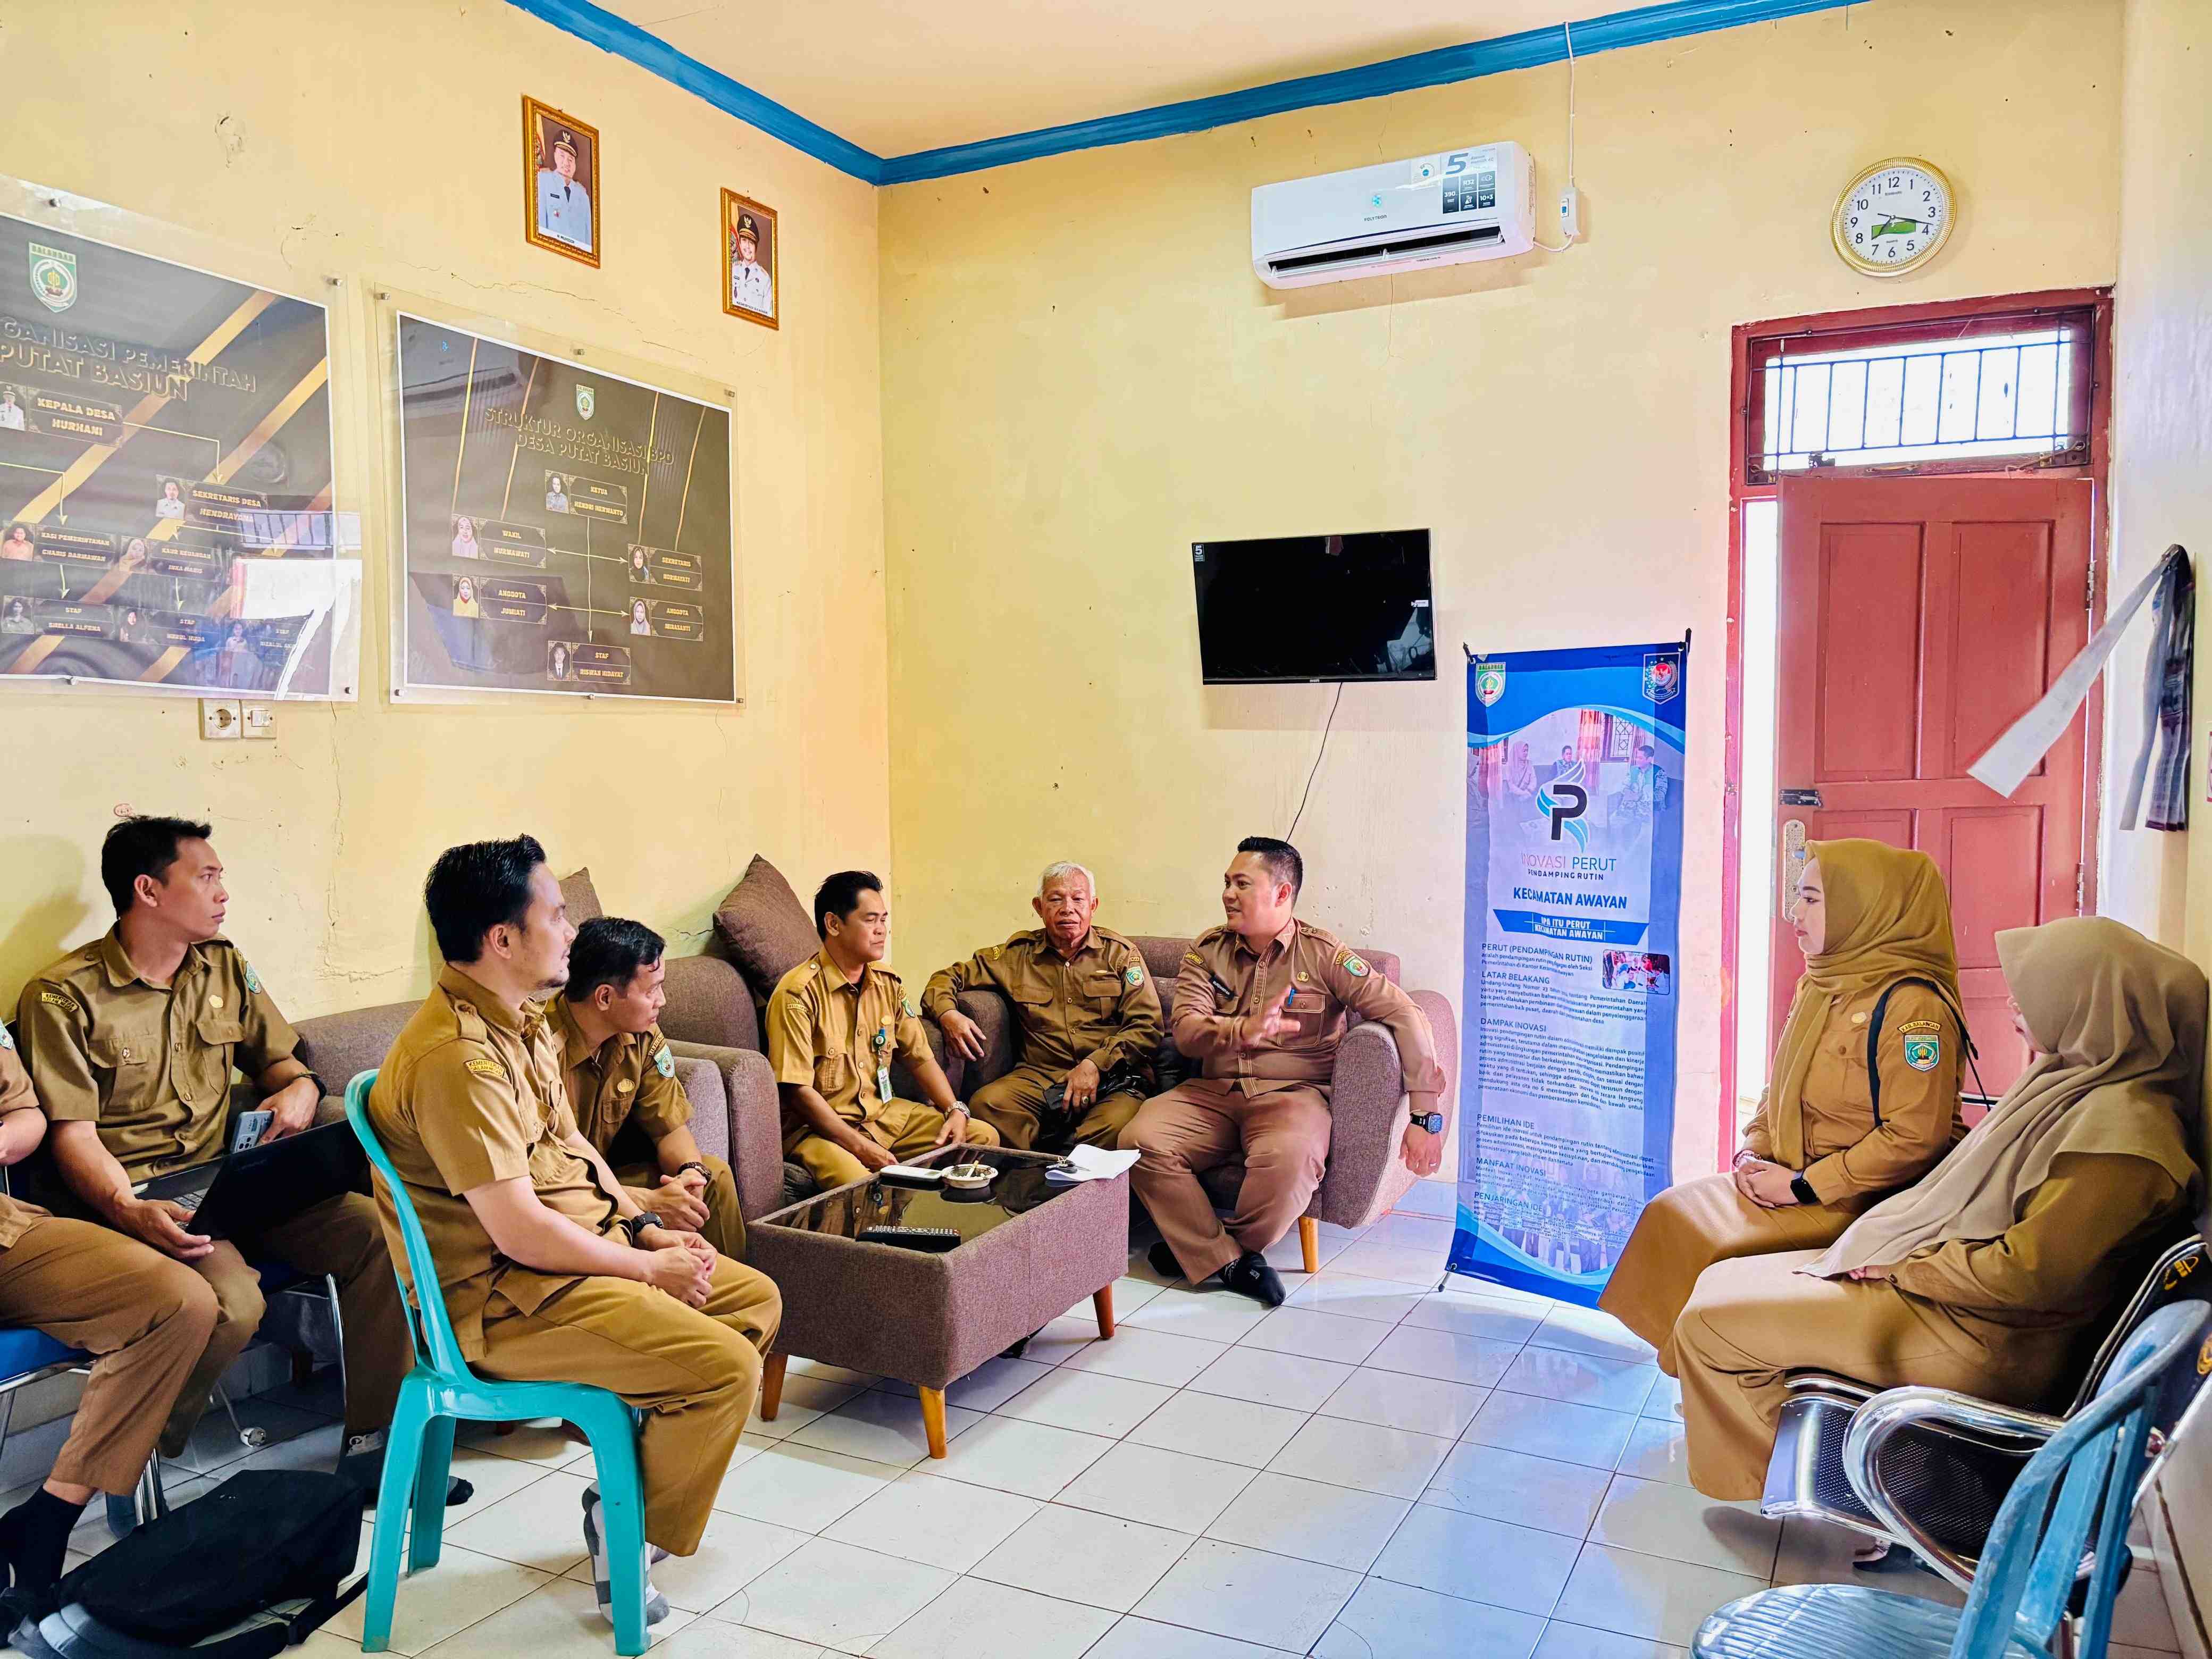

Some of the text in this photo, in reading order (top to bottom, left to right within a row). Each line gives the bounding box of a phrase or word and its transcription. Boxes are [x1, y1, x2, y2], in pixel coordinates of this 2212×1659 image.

[1445, 153, 1468, 174] 5
[1889, 177, 1899, 188] 12
[1910, 179, 1913, 189] 1
[1872, 183, 1881, 195] 11
[1923, 191, 1930, 202] 2
[1857, 199, 1869, 210] 10
[1928, 207, 1936, 217] 3
[1850, 217, 1858, 228] 9
[1922, 224, 1929, 235] 4
[1856, 233, 1863, 244] 8
[1872, 245, 1879, 255] 7
[1907, 240, 1914, 250] 5
[1888, 247, 1895, 257] 6
[0, 342, 83, 378] PUTAT
[123, 347, 256, 392] PEMERINTAH
[37, 398, 115, 421] KEPALA DESA
[485, 408, 674, 465] STRUKTUR ORGANISASI BPD
[517, 434, 555, 454] DESA
[559, 443, 600, 464] PUTAT
[590, 485, 608, 495] KETUA
[192, 490, 261, 507] SEKRETARIS DESA
[502, 530, 522, 539] WAKIL
[1195, 545, 1202, 555] 5
[662, 557, 691, 567] SEKRETARIS
[498, 590, 526, 599] ANGGOTA
[1551, 784, 1588, 841] P
[1572, 857, 1617, 872] PERUT
[1514, 887, 1627, 909] KECAMATAN AWAYAN
[1552, 918, 1563, 927] ITU
[1566, 919, 1590, 929] PERUT
[1569, 929, 1603, 940] AWAYAN
[1565, 953, 1592, 964] RUTIN)
[1509, 974, 1549, 984] BELAKANG
[1481, 1018, 1546, 1032] DAMPAK INOVASI
[1477, 1114, 1521, 1127] PEMILIHAN
[1477, 1157, 1546, 1177] MANFAAT INOVASI
[1474, 1192, 1531, 1209] PENJARINGAN
